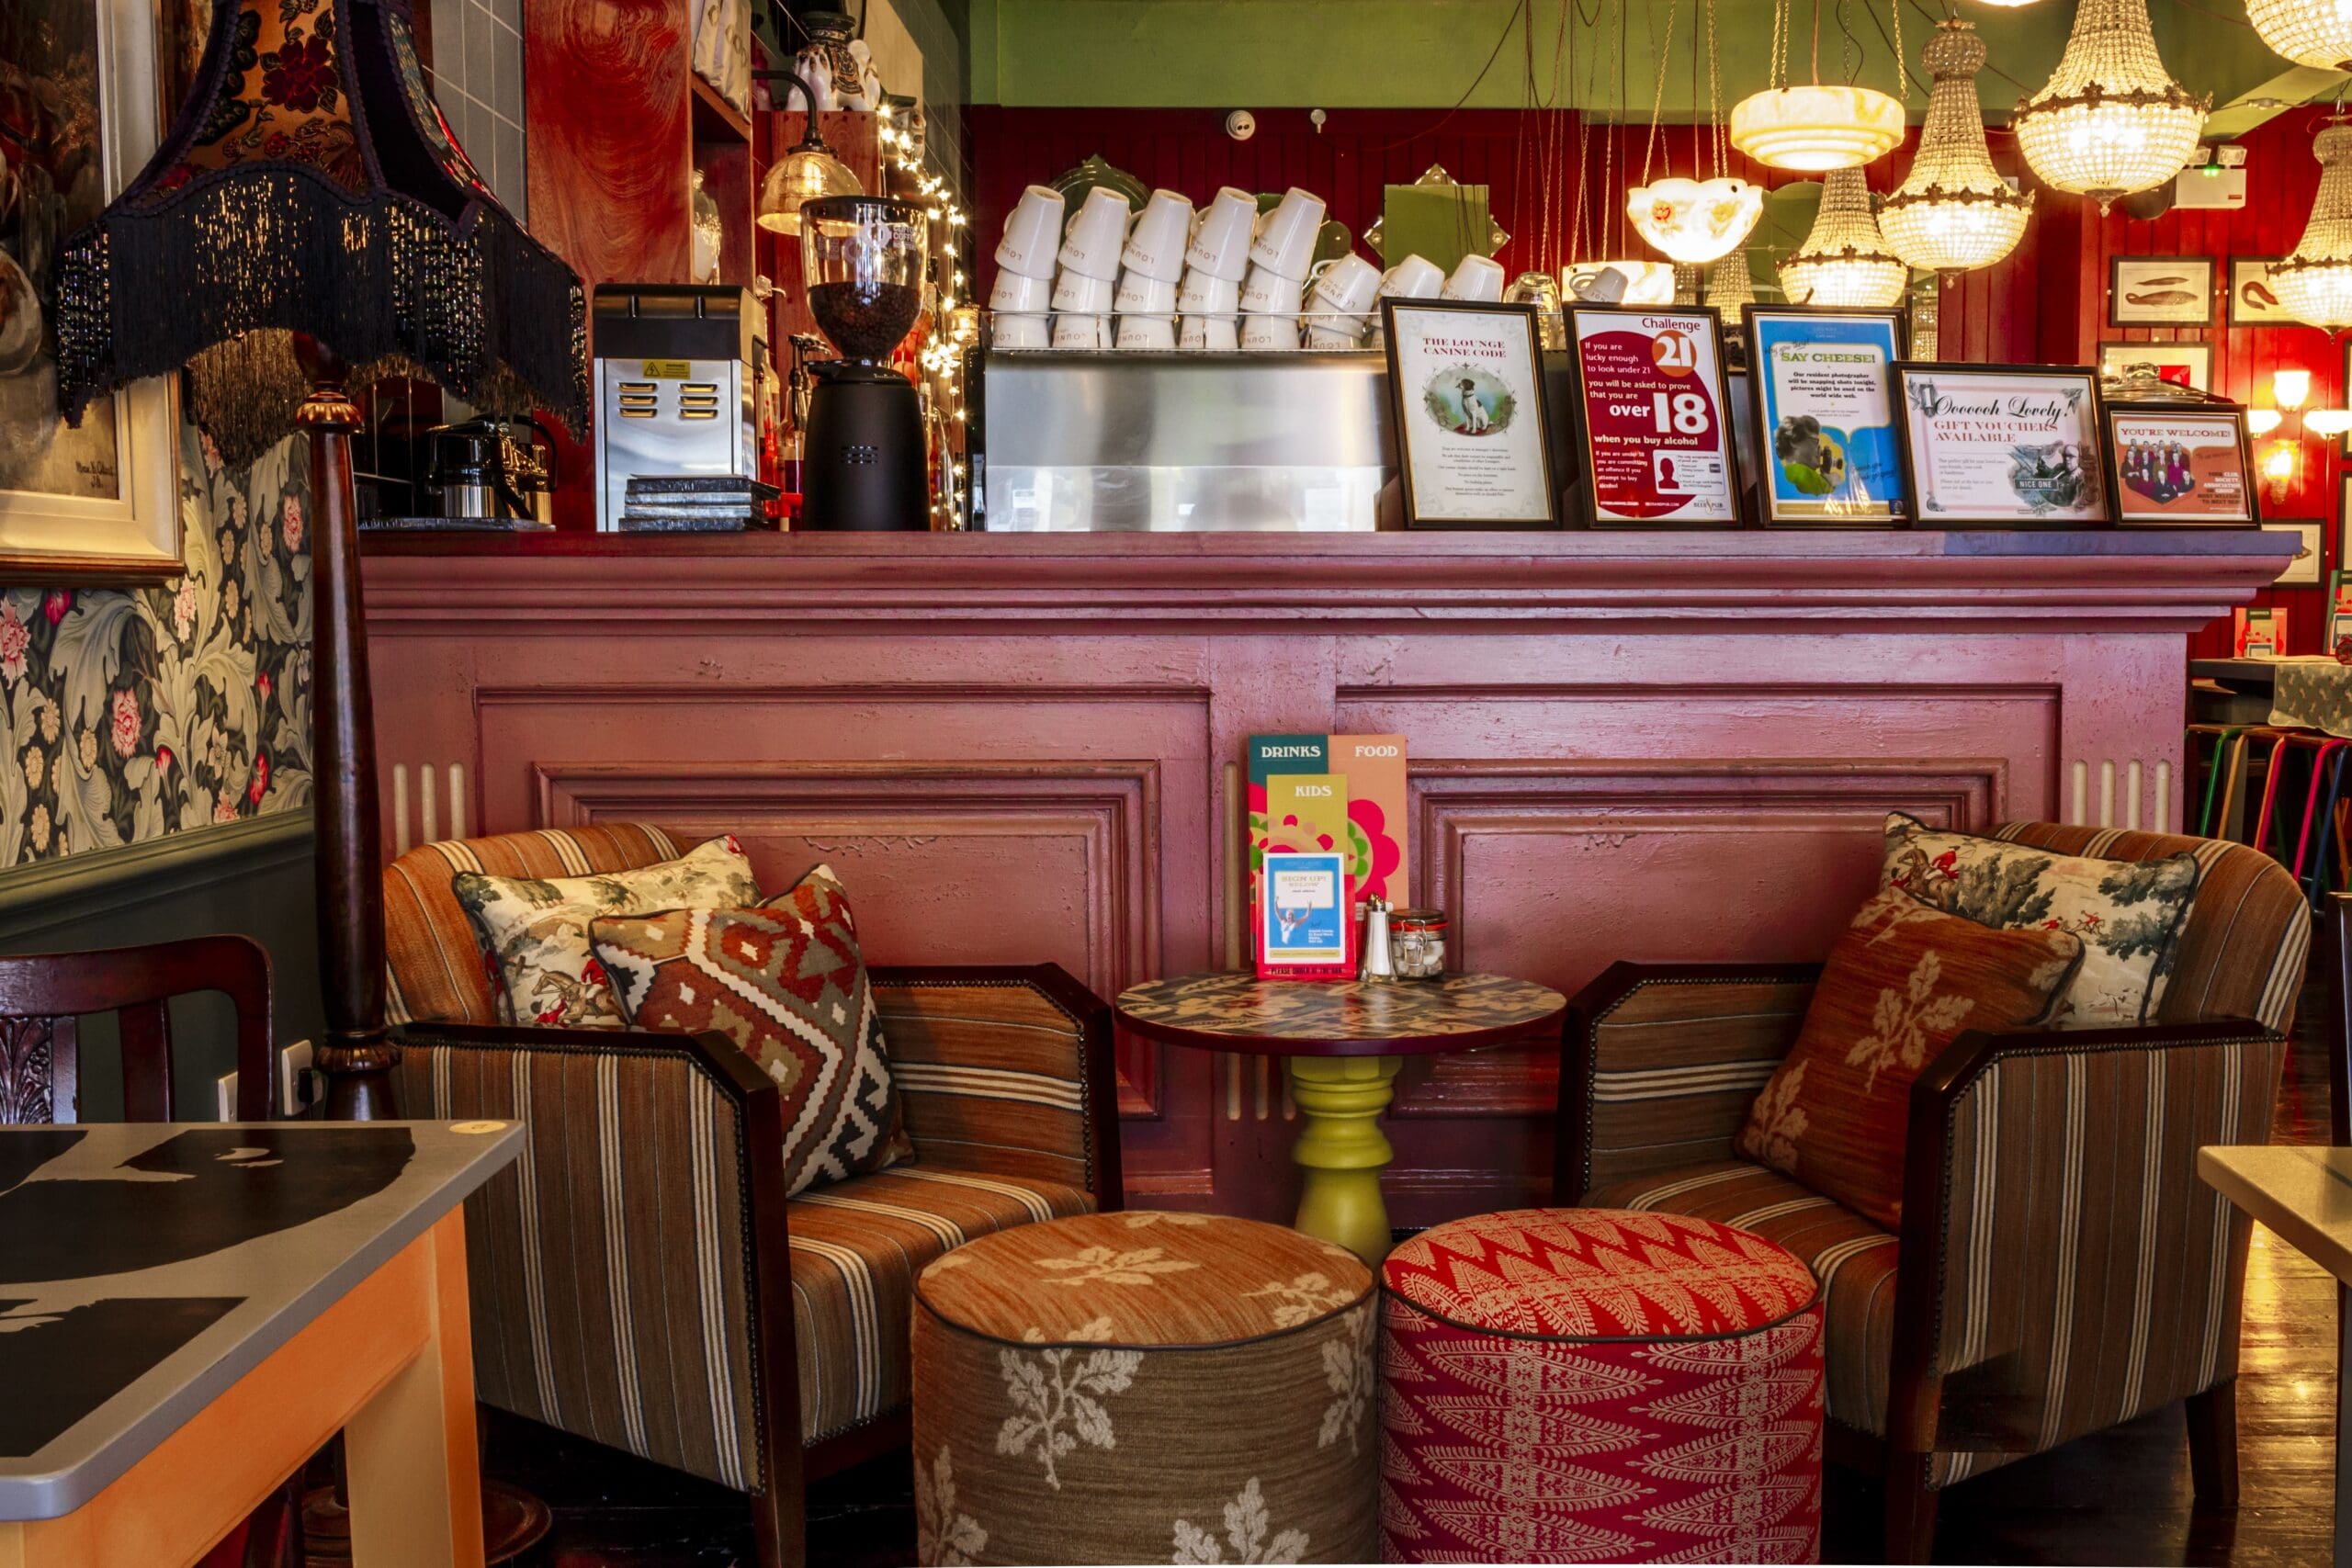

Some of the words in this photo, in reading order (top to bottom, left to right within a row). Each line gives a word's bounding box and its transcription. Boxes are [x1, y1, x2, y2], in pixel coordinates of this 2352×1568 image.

[1642, 317, 1701, 333] Challenge
[1423, 338, 1448, 346] THE
[1453, 338, 1505, 348] LOUNGE
[1424, 347, 1470, 356] CANINE
[1473, 350, 1506, 358] CODE
[1656, 336, 1692, 367] 21
[1586, 354, 1606, 363] lucky
[1608, 355, 1638, 364] enough
[1781, 353, 1809, 362] SAY
[1812, 353, 1876, 363] CHEESE!
[1609, 405, 1651, 417] over
[1653, 392, 1709, 434] 18
[1934, 421, 1970, 429] GIFT
[1975, 421, 2058, 432] VOUCHERS
[1935, 433, 2016, 443] AVAILABLE
[2166, 429, 2231, 437] WELCOME!
[1594, 434, 1620, 443] when
[1623, 436, 1641, 445] you
[1644, 435, 1661, 446] buy
[1261, 745, 1321, 758] DRINKS
[1355, 745, 1398, 757] FOOD
[1295, 785, 1332, 797] KIDS
